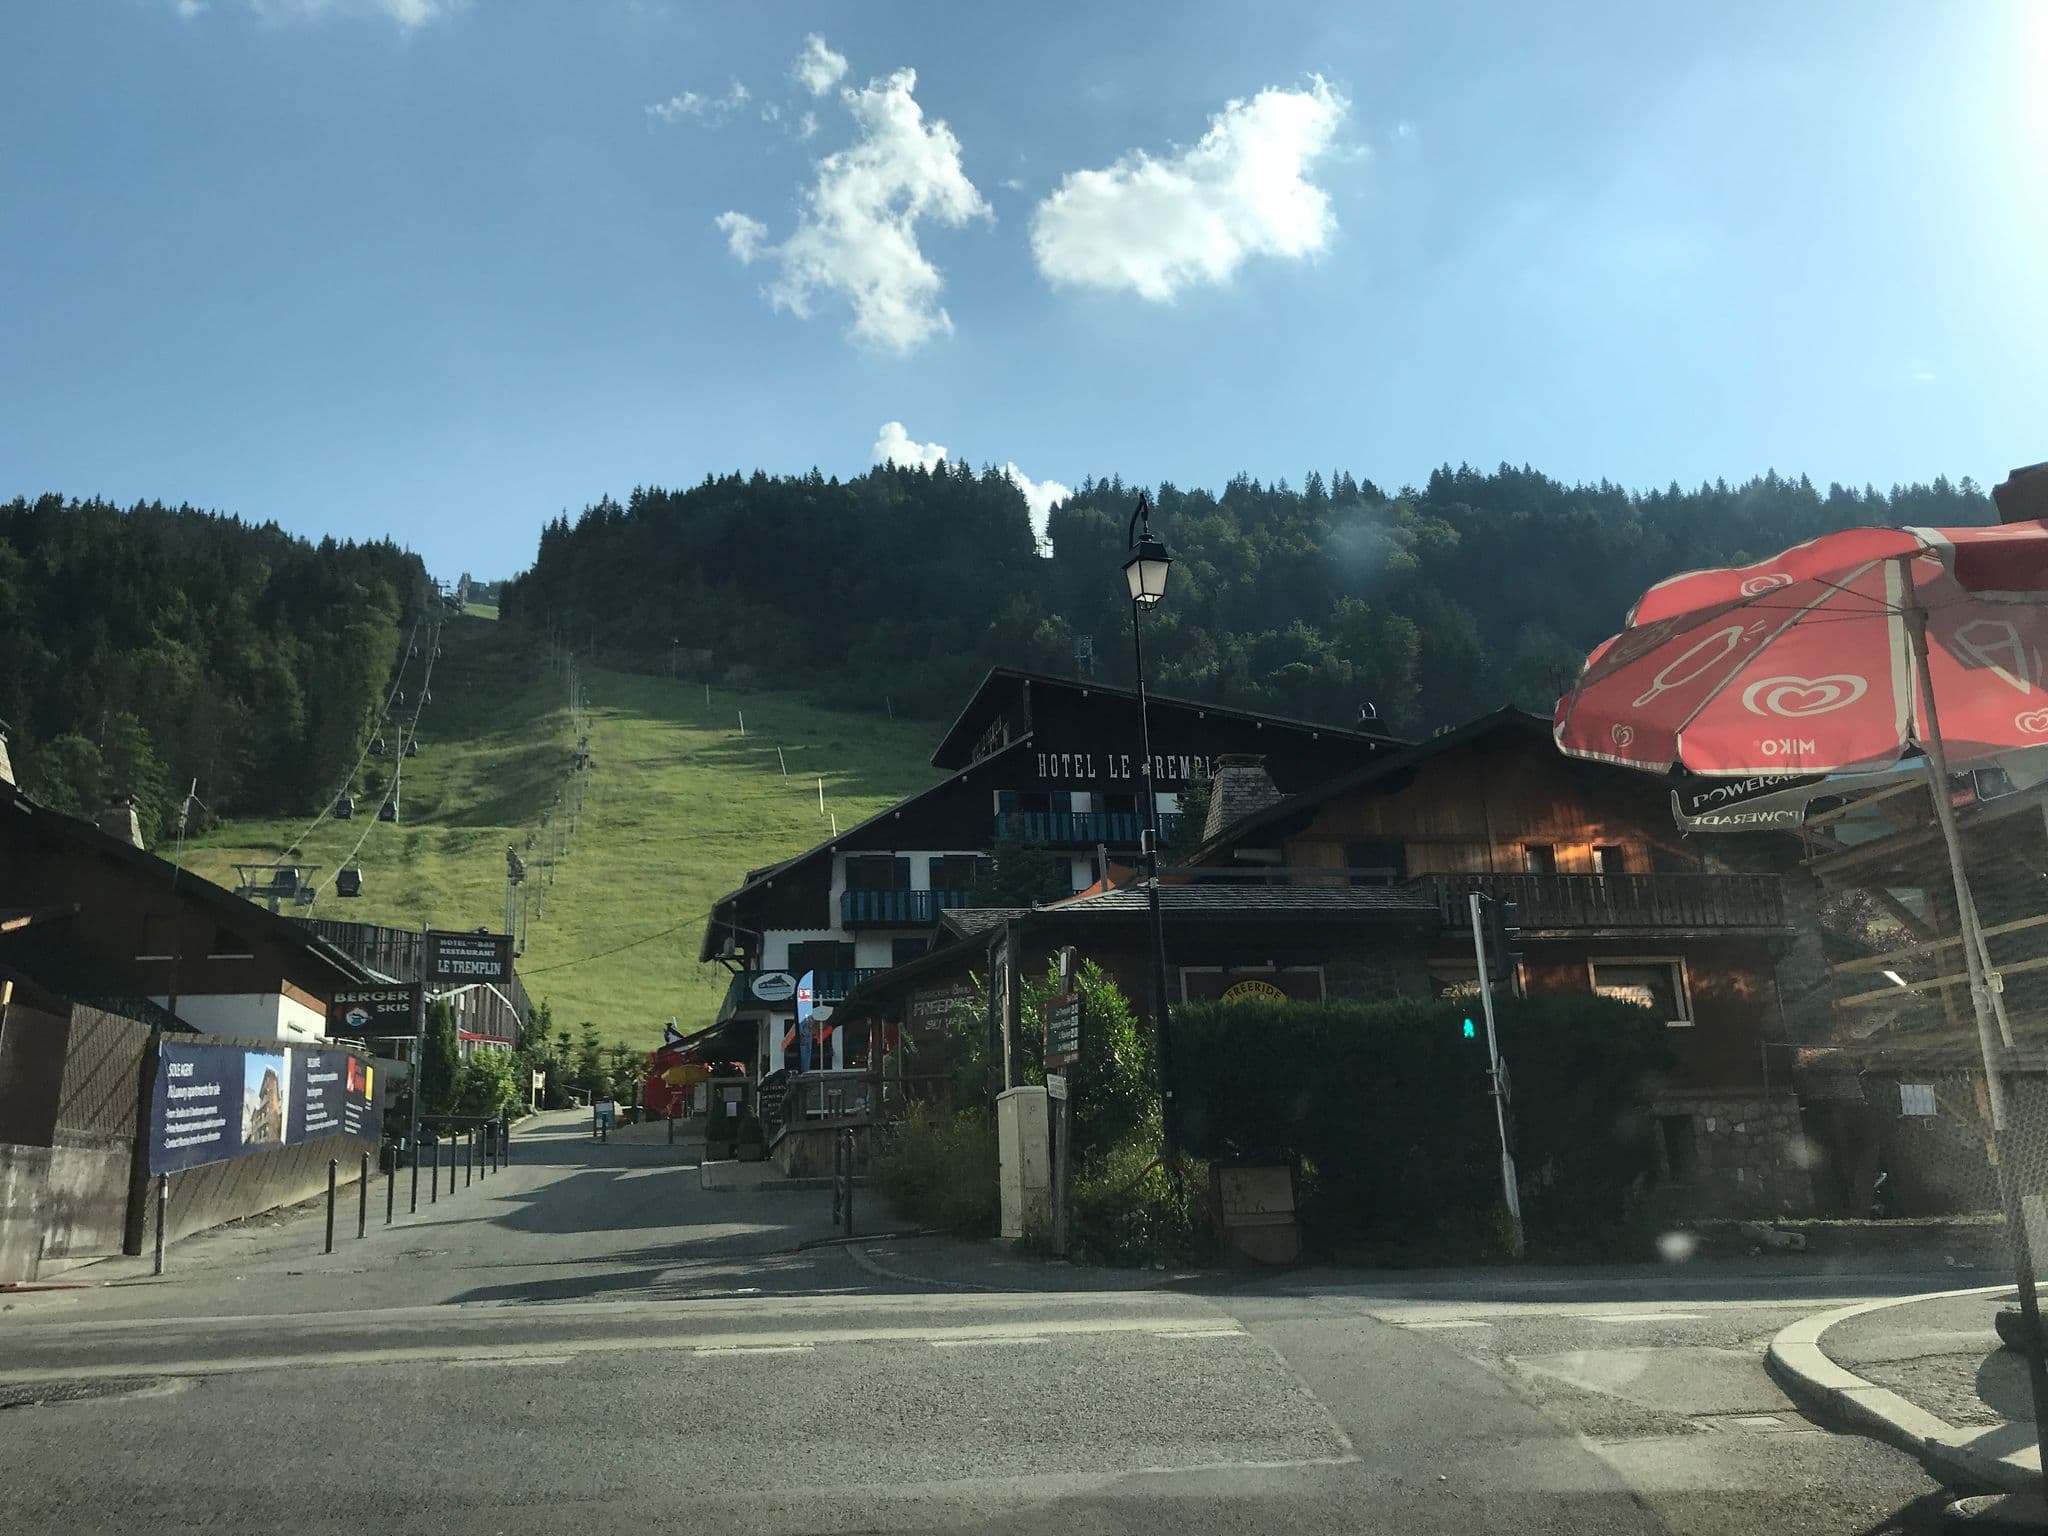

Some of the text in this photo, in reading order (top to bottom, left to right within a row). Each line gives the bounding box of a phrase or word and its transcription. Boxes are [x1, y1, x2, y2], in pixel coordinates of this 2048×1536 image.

[1038, 753, 1216, 780] HOTEL LE REMPL
[1693, 774, 1807, 807] POWERA
[440, 948, 496, 956] RESTAURANT
[438, 960, 501, 975] LE TREMPLIN
[334, 991, 410, 1003] BERGER
[1227, 982, 1281, 1000] FREERIDE
[376, 1003, 410, 1013] SKIS
